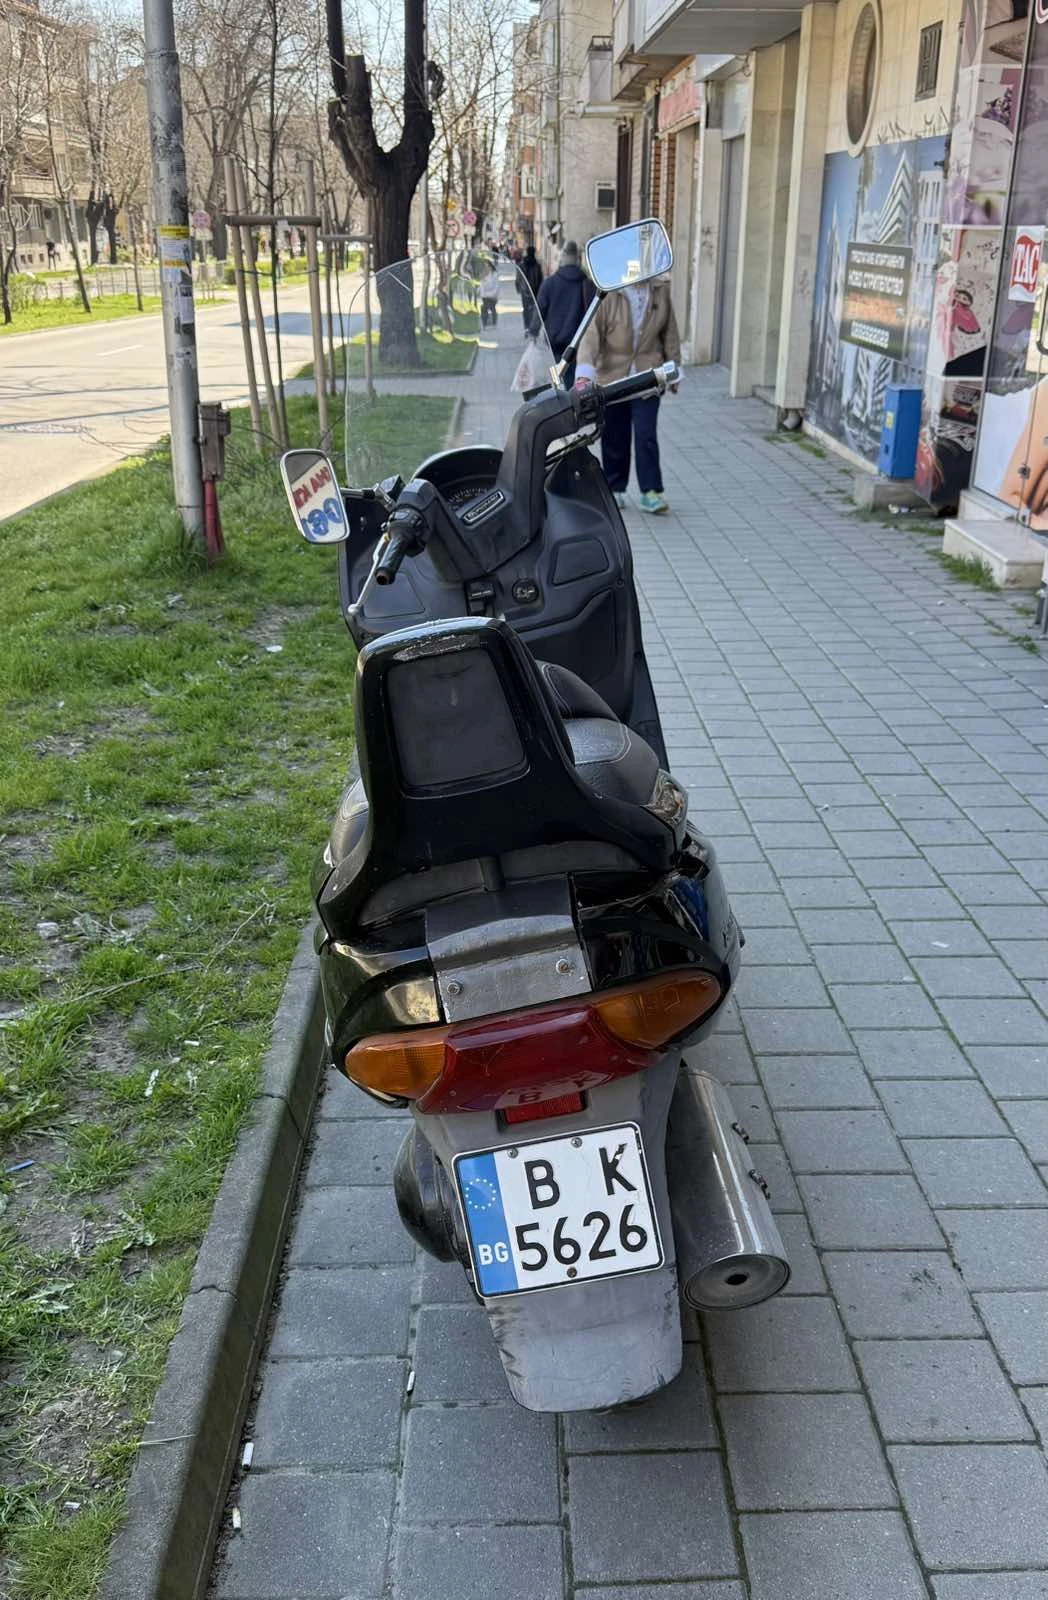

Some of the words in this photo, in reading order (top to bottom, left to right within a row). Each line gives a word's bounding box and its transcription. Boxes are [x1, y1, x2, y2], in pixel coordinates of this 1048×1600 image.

[524, 1159, 560, 1210] B
[599, 1143, 638, 1196] K
[478, 1242, 509, 1265] BG
[515, 1204, 648, 1271] 5626
